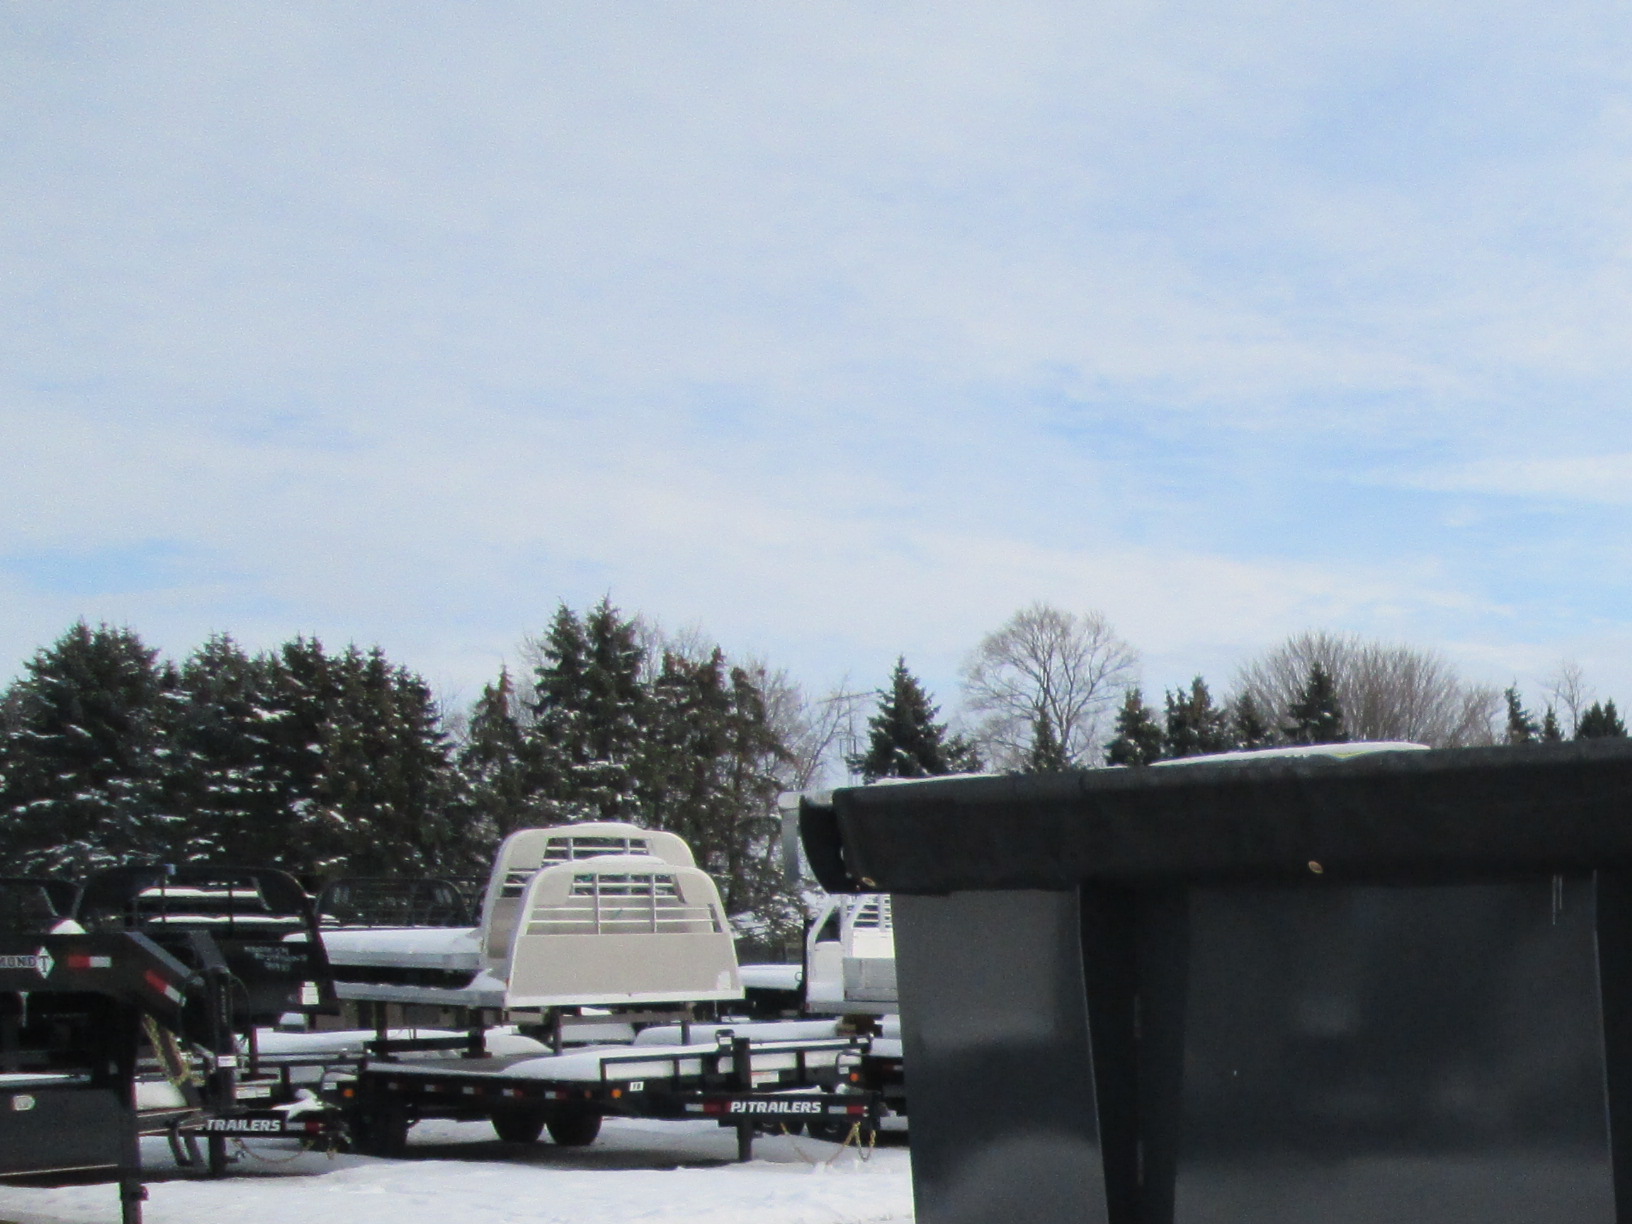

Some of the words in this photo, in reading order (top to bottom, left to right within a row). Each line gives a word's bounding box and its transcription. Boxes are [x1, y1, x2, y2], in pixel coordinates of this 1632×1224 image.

[730, 1101, 747, 1114] PJ
[747, 1101, 822, 1114] TRAILERS
[206, 1119, 282, 1132] TRAILERS
